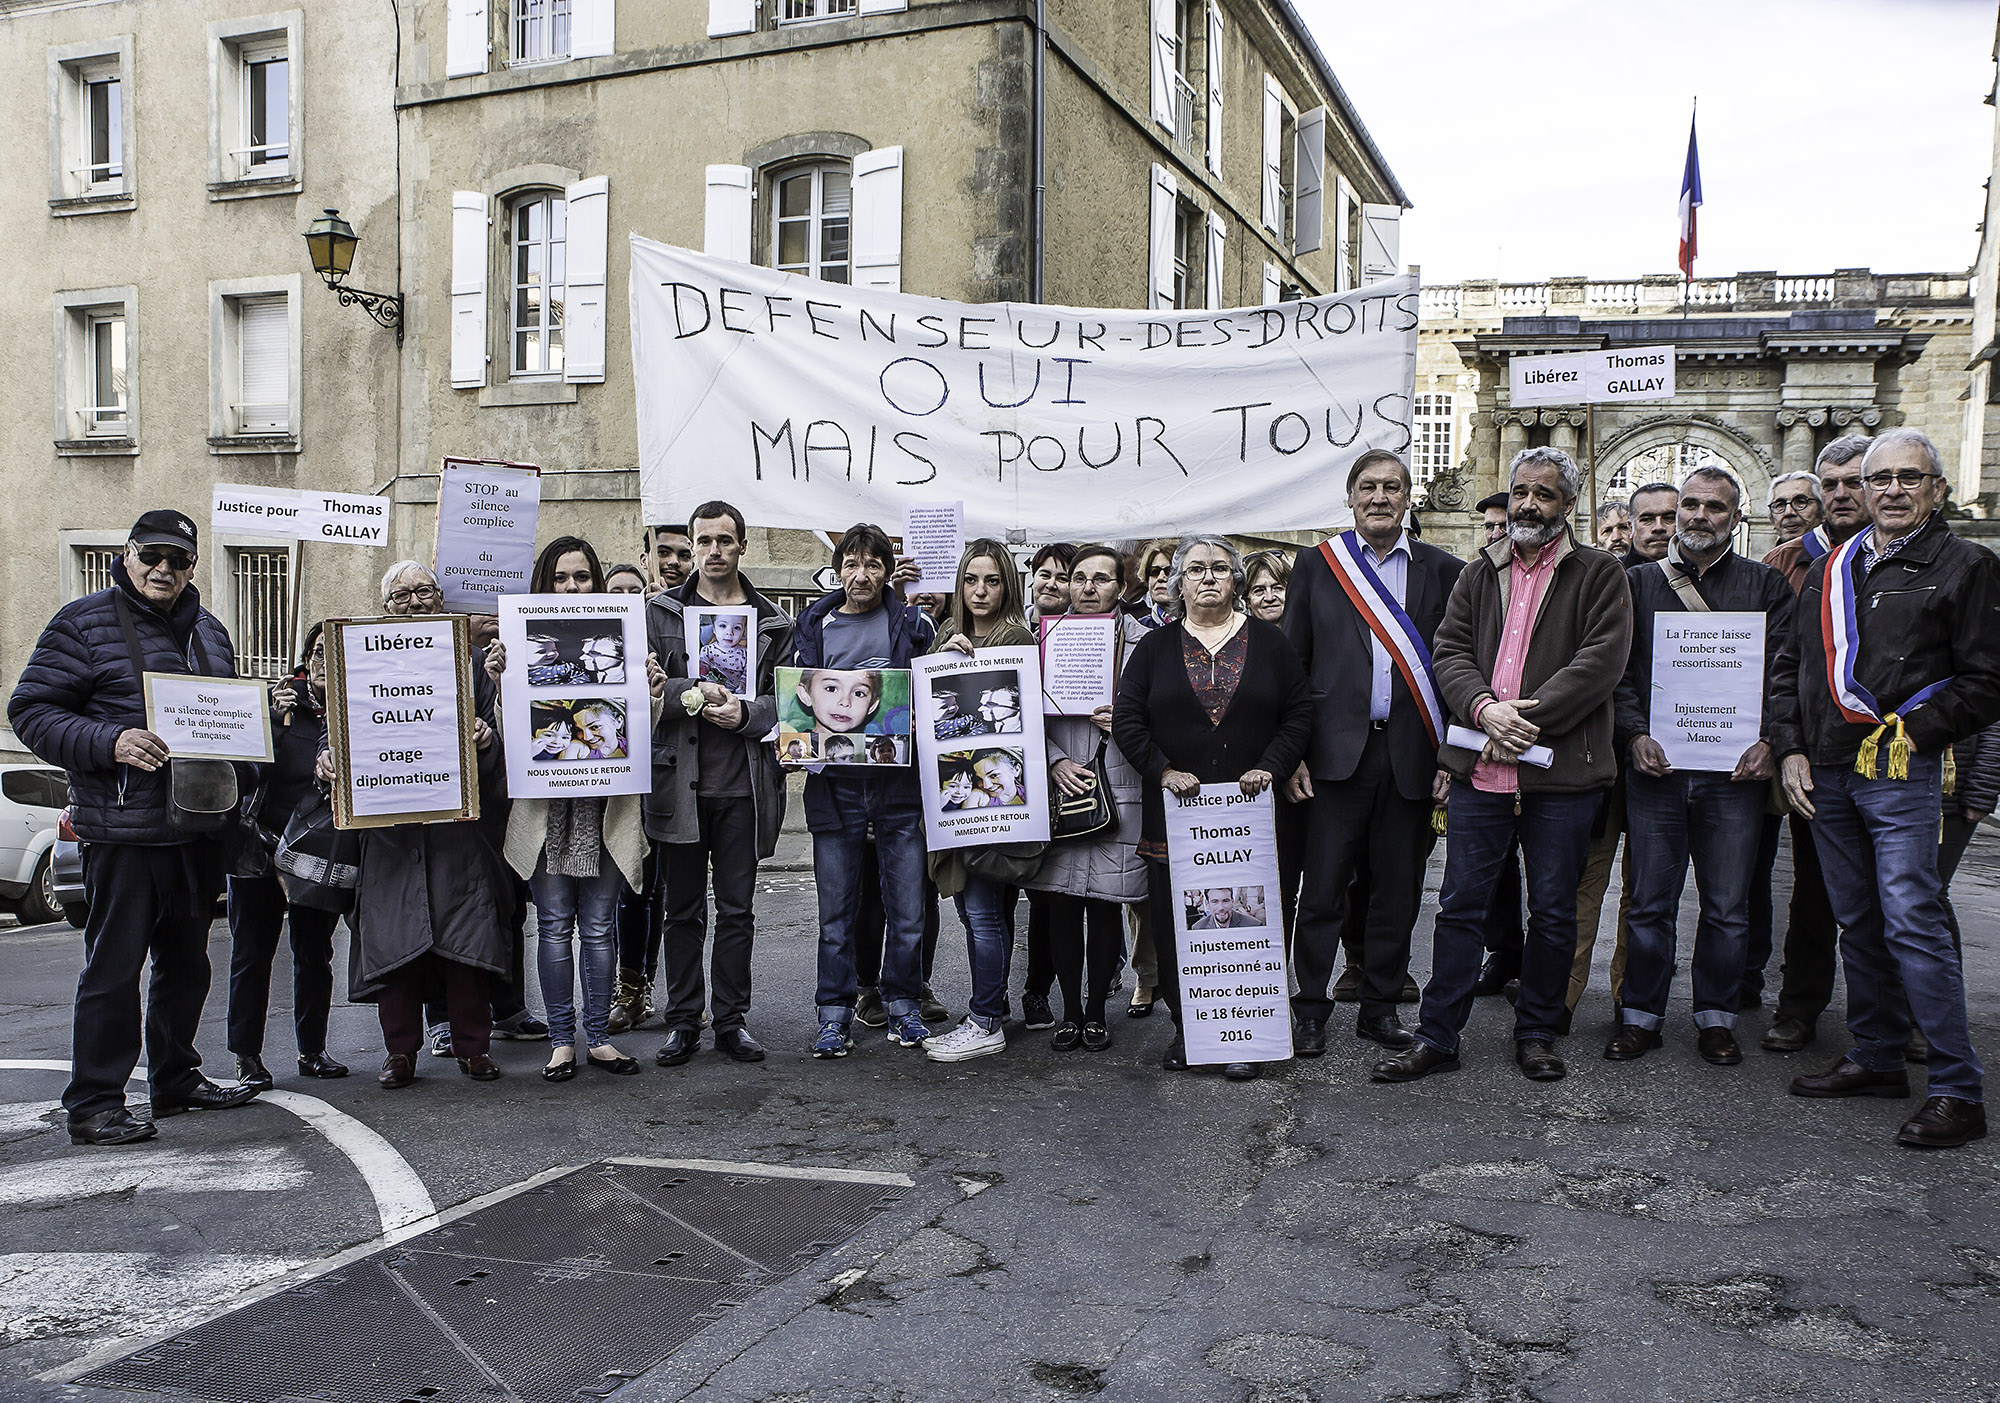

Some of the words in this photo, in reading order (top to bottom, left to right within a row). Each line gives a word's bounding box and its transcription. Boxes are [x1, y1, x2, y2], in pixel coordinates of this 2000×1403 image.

[1606, 355, 1665, 368] Thomas
[1525, 369, 1578, 384] Libérez
[1675, 371, 1767, 387] CTURE
[879, 357, 1092, 416] OUI
[1608, 377, 1664, 393] GALLAY
[751, 418, 937, 485] MAIS
[980, 416, 1188, 482] POUR
[1212, 393, 1412, 463] TOUS
[465, 483, 499, 495] STOP
[505, 489, 518, 497] au
[217, 500, 263, 514] Justice
[267, 507, 299, 517] pour
[323, 499, 382, 516] Thomas
[471, 499, 510, 512] silence
[463, 516, 514, 529] complice
[322, 524, 380, 539] GALLAY
[479, 551, 492, 562] du
[444, 566, 523, 579] gouvernement
[462, 579, 504, 594] français
[518, 606, 559, 614] TOUJOURS
[1666, 629, 1679, 639] La
[1683, 629, 1718, 639] France
[1722, 629, 1751, 639] laisse
[365, 633, 434, 651] Libérez
[1680, 644, 1717, 653] tomber
[1719, 646, 1736, 654] ses
[924, 662, 958, 674] TOUJOURS
[959, 660, 978, 668] AVEC
[1672, 658, 1742, 668] ressortissants
[369, 684, 433, 698] Thomas
[197, 694, 219, 706] Stop
[178, 705, 211, 716] silence
[213, 710, 252, 723] complice
[372, 708, 434, 724] GALLAY
[1675, 703, 1736, 716] Injustement
[174, 717, 185, 726] de
[188, 718, 196, 726] la
[198, 719, 245, 733] diplomatie
[1677, 718, 1717, 728] détenus
[192, 730, 231, 741] française
[1687, 732, 1721, 743] Maroc
[379, 750, 423, 763] otage
[551, 768, 589, 776] VOULONS
[601, 766, 631, 774] RETOUR
[356, 771, 450, 789] diplomatique
[549, 779, 589, 787] IMMEDIAT
[591, 778, 610, 786] D'ALI
[1177, 795, 1222, 809] Justice
[1226, 795, 1256, 810] pour
[938, 819, 955, 828] NOUS
[956, 815, 989, 825] VOULONS
[1000, 813, 1030, 821] RETOUR
[955, 826, 990, 837] IMMEDIAT
[991, 825, 1010, 833] D'ALI
[1189, 826, 1251, 840] Thomas
[1193, 849, 1252, 865] GALLAY
[1190, 938, 1270, 955] injustement
[1182, 960, 1261, 977] emprisonné
[1265, 962, 1281, 971] au
[1189, 987, 1232, 999] Maroc
[1235, 983, 1279, 998] depuis
[1196, 1009, 1208, 1020] le
[1212, 1008, 1228, 1019] 18
[1231, 1006, 1275, 1018] février
[1220, 1029, 1252, 1042] 2016
